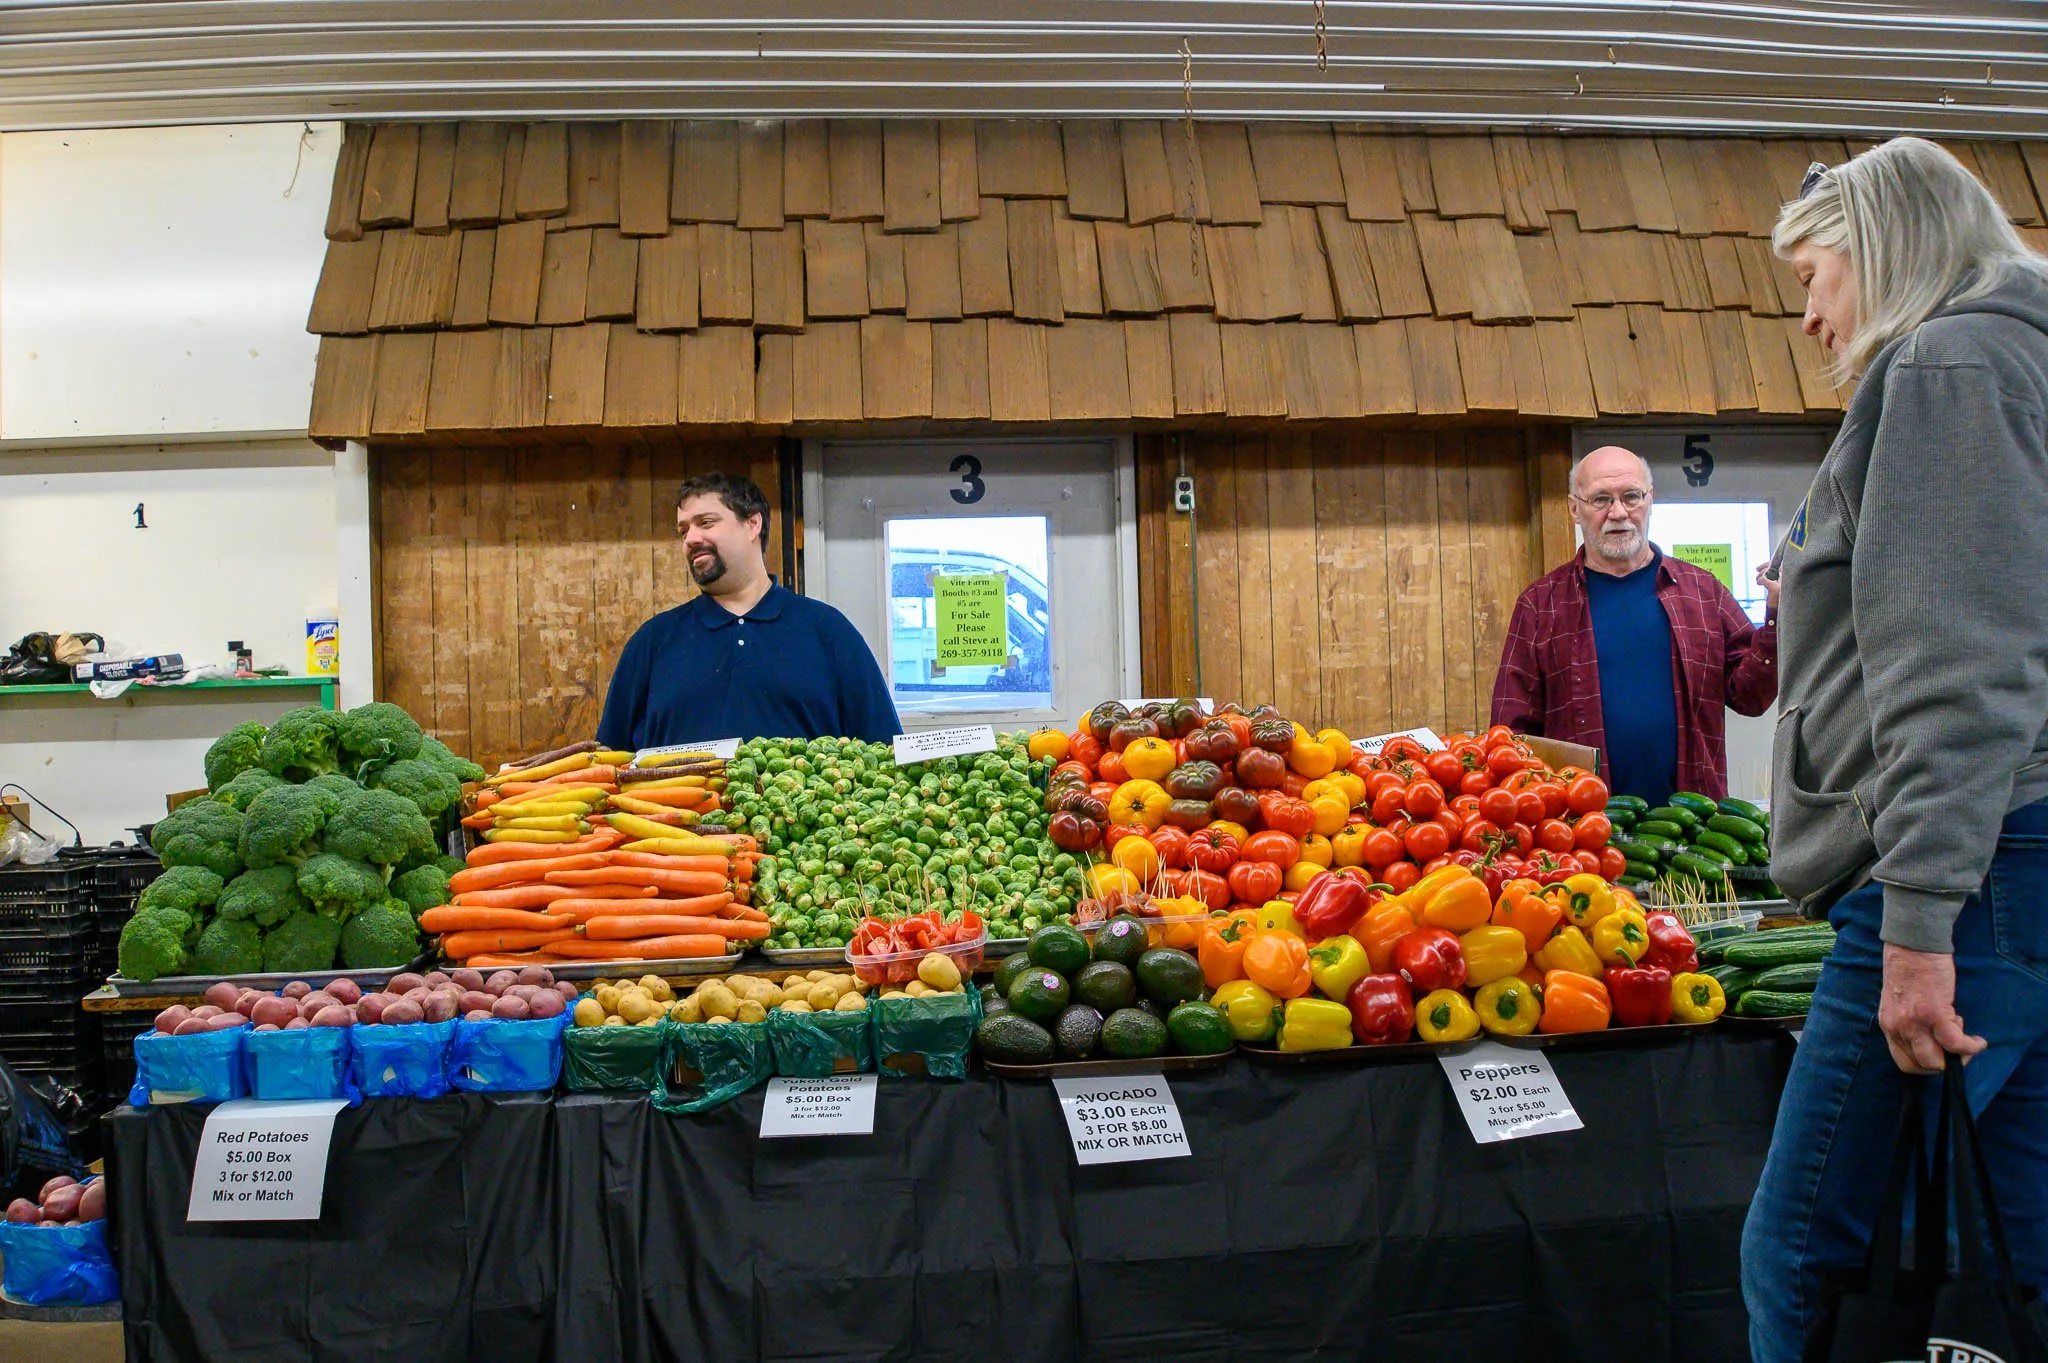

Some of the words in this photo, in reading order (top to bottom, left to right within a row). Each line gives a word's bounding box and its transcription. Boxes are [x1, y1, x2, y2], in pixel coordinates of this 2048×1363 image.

[1682, 434, 1713, 487] 5
[949, 455, 985, 504] 3
[133, 502, 148, 528] 1
[942, 589, 970, 597] Booths
[971, 589, 981, 597] #3
[982, 588, 998, 596] and
[951, 611, 968, 620] For
[970, 610, 991, 619] Sale
[315, 626, 335, 638] Lysol
[956, 623, 986, 632] Please
[943, 636, 960, 645] call
[962, 636, 988, 645] Steve
[941, 648, 1003, 658] 269-357-9118
[99, 661, 133, 673] DISPOSABLE
[105, 669, 128, 678] GLOVES
[945, 727, 987, 735] Sprouts
[1460, 1064, 1541, 1081] Peppers
[788, 1085, 851, 1093] Potatoes
[1470, 1085, 1518, 1103] $2.00
[1522, 1085, 1551, 1096] Each
[785, 1095, 823, 1104] $5.00
[1075, 1087, 1157, 1104] AVOCADO
[1077, 1105, 1126, 1122] $3.00
[1130, 1105, 1167, 1117] EACH
[1489, 1106, 1497, 1115] 3
[1498, 1105, 1514, 1114] for
[1516, 1100, 1546, 1112] $5.00
[1487, 1117, 1509, 1127] Mix
[1510, 1115, 1522, 1124] or
[1085, 1125, 1094, 1136] 3
[1097, 1122, 1129, 1134] FOR
[1131, 1119, 1168, 1132] $8.00
[216, 1131, 245, 1143] Red
[247, 1131, 309, 1143] Potatoes
[1077, 1139, 1105, 1151] MIX
[1107, 1136, 1130, 1148] OR
[1132, 1132, 1184, 1147] MATCH
[226, 1151, 263, 1164] $5.00
[266, 1152, 292, 1163] Box
[219, 1171, 227, 1182] 3
[230, 1171, 249, 1182] for
[251, 1170, 293, 1183] $12.00
[212, 1190, 235, 1201] Mix
[238, 1191, 252, 1201] or
[255, 1189, 294, 1201] Match
